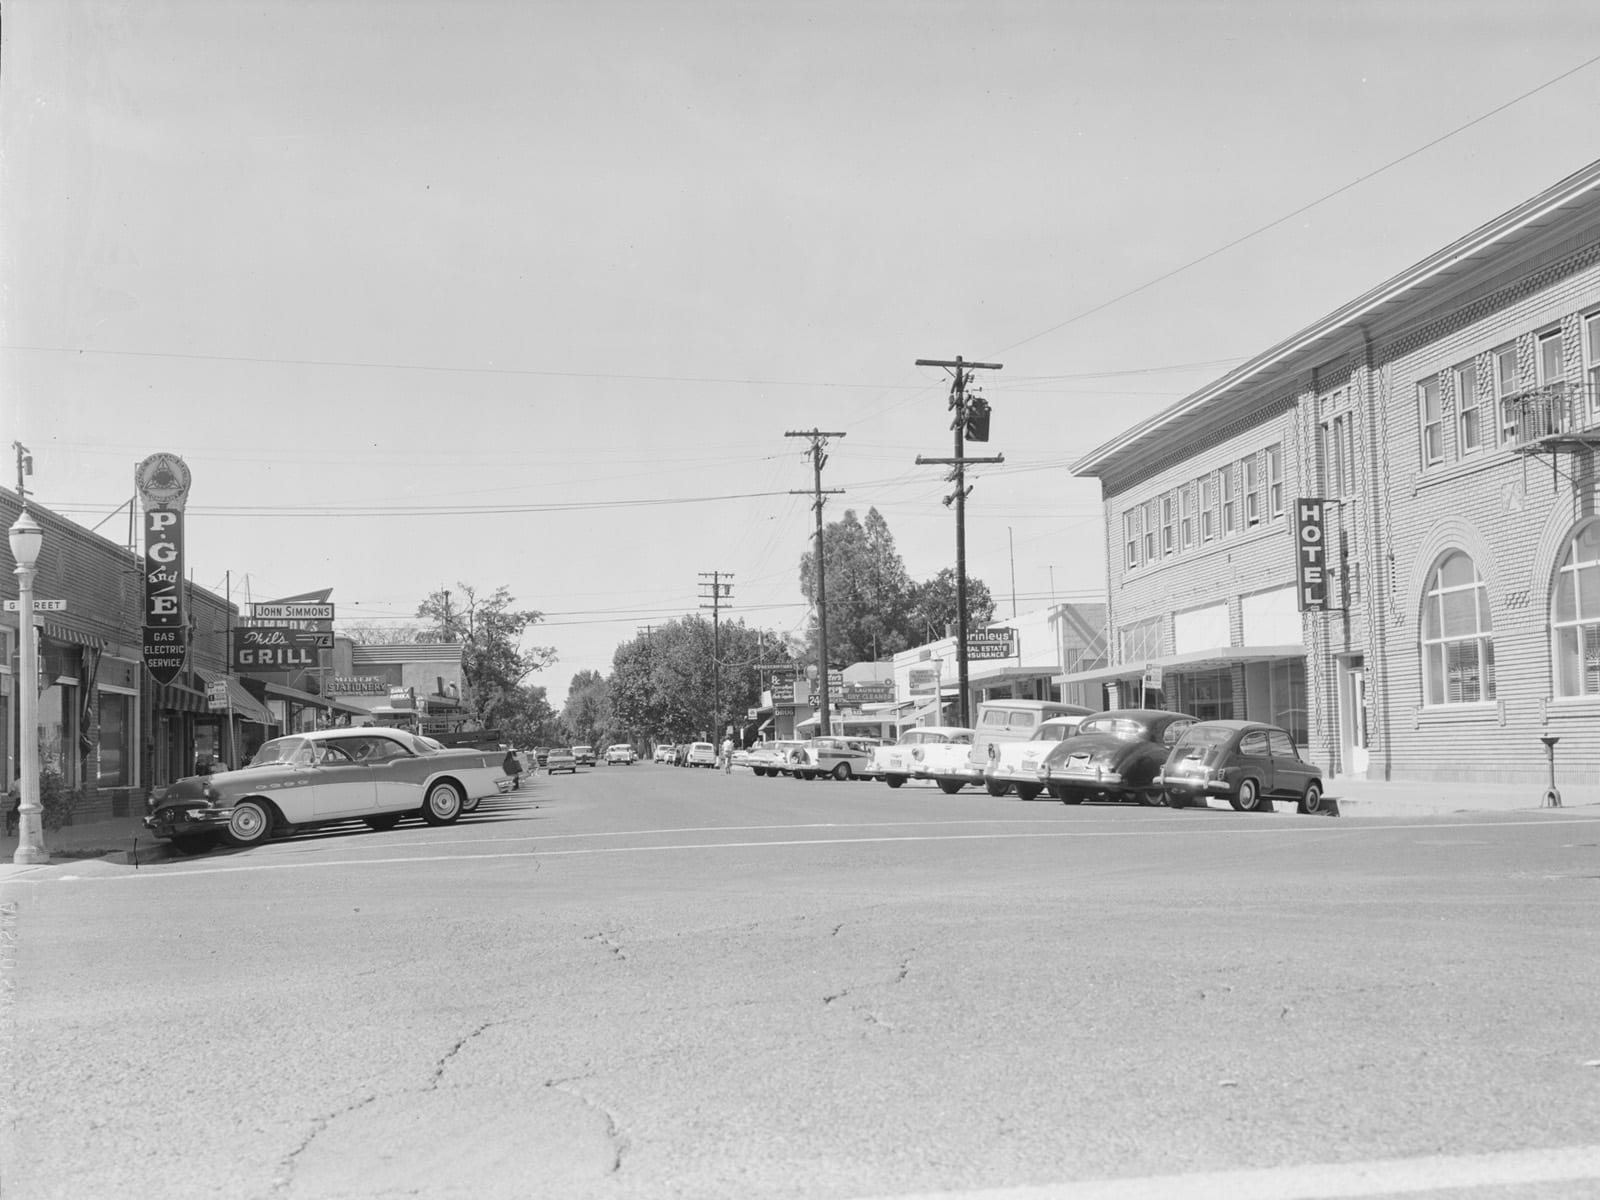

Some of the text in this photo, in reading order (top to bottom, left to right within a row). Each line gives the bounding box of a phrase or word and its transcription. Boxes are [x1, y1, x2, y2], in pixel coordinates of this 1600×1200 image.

[1301, 505, 1322, 604] HOTEL
[33, 601, 61, 609] REET
[257, 606, 330, 617] JOHN SIMMONS
[154, 632, 175, 641] GAS
[244, 631, 289, 645] Phil's
[144, 645, 185, 654] ELECTRIC
[239, 648, 313, 665] GRILL
[148, 658, 181, 667] SERVICE
[328, 682, 386, 692] STATIONERY
